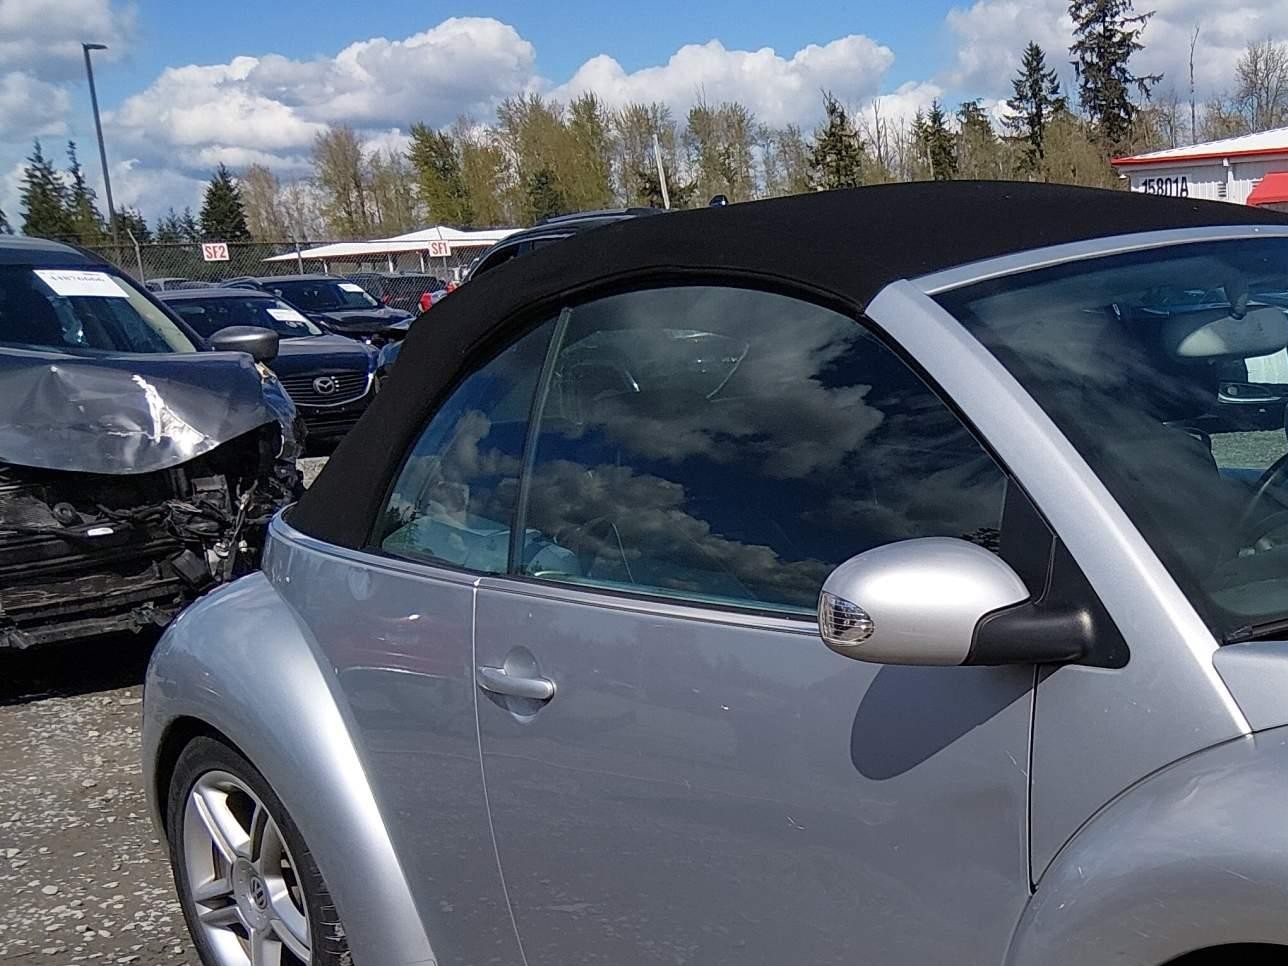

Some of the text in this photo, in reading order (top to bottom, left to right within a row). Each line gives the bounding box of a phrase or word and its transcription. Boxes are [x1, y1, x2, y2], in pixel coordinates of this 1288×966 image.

[1142, 176, 1189, 198] 15801A
[205, 245, 227, 259] SF2
[431, 242, 448, 255] SF1
